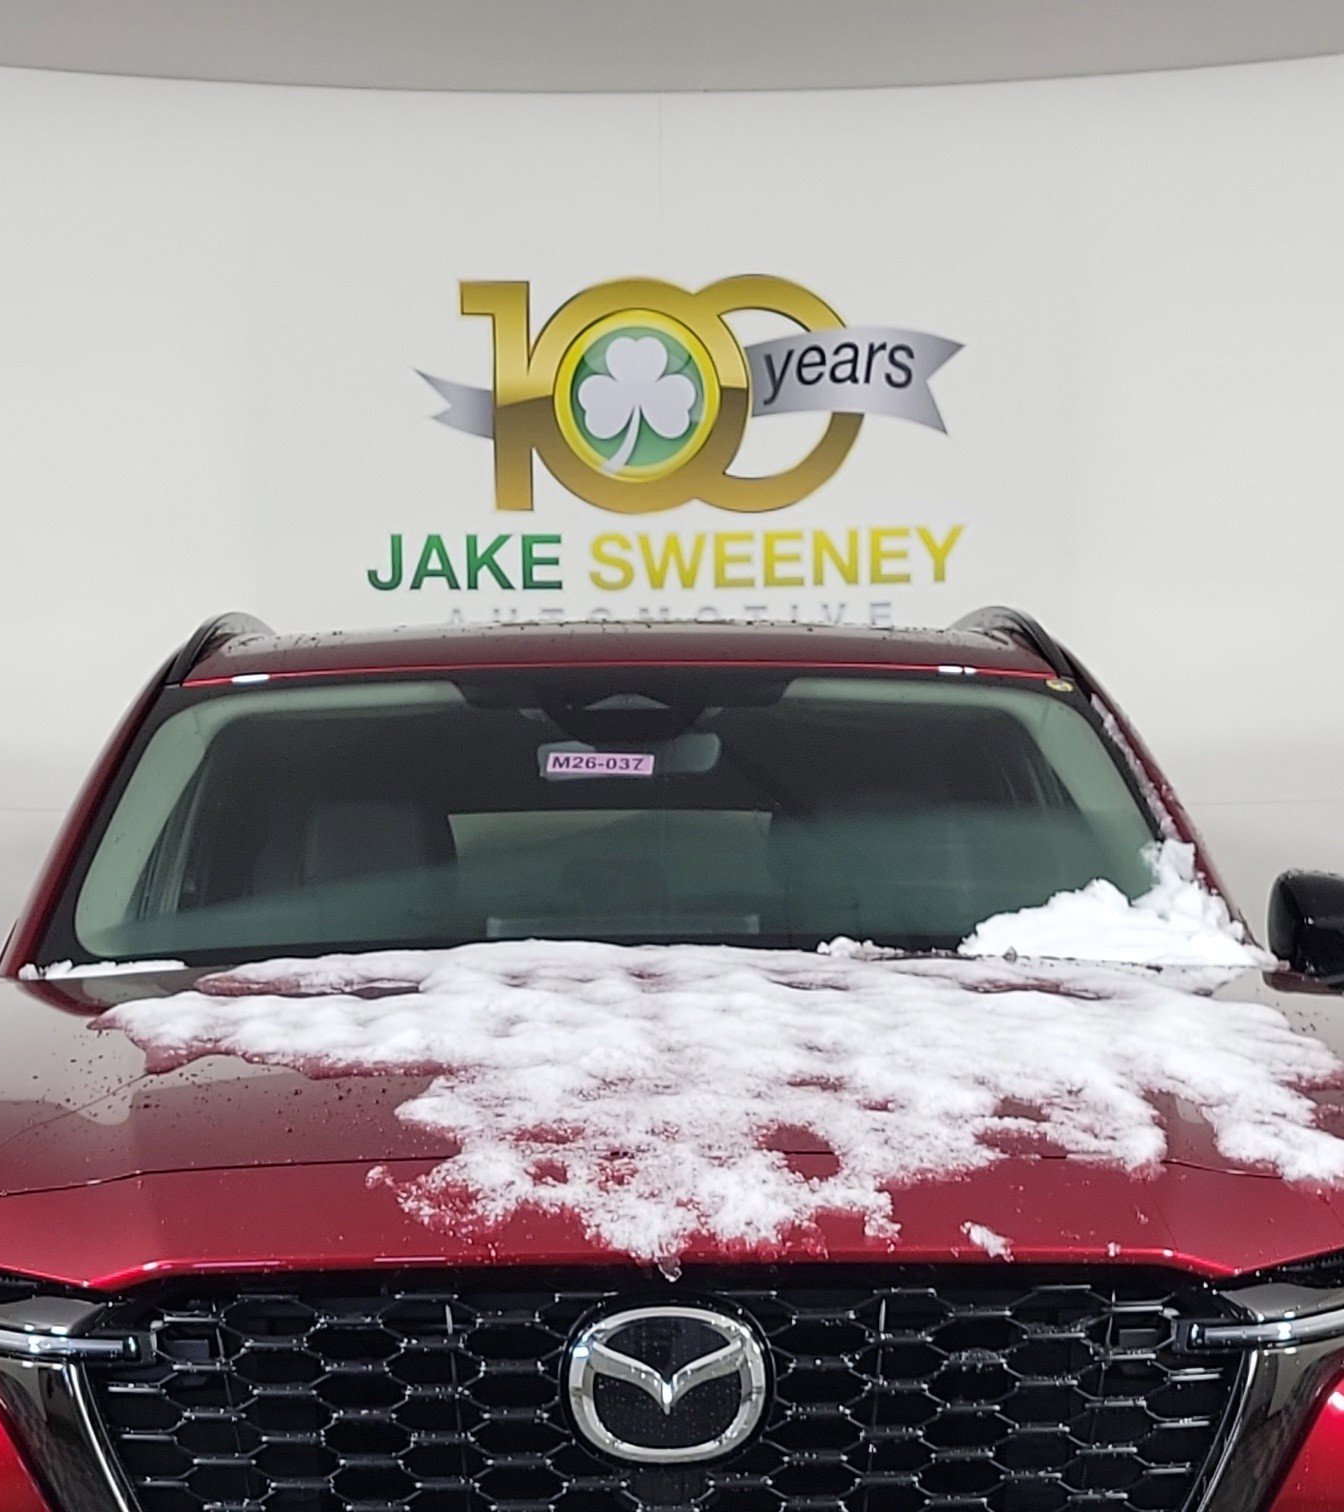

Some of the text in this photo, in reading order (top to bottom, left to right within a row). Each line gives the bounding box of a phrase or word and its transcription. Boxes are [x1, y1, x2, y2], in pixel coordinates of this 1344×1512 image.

[459, 273, 916, 514] 100 years
[366, 523, 965, 591] JAKE SWEENEY
[552, 756, 644, 771] M26-037
